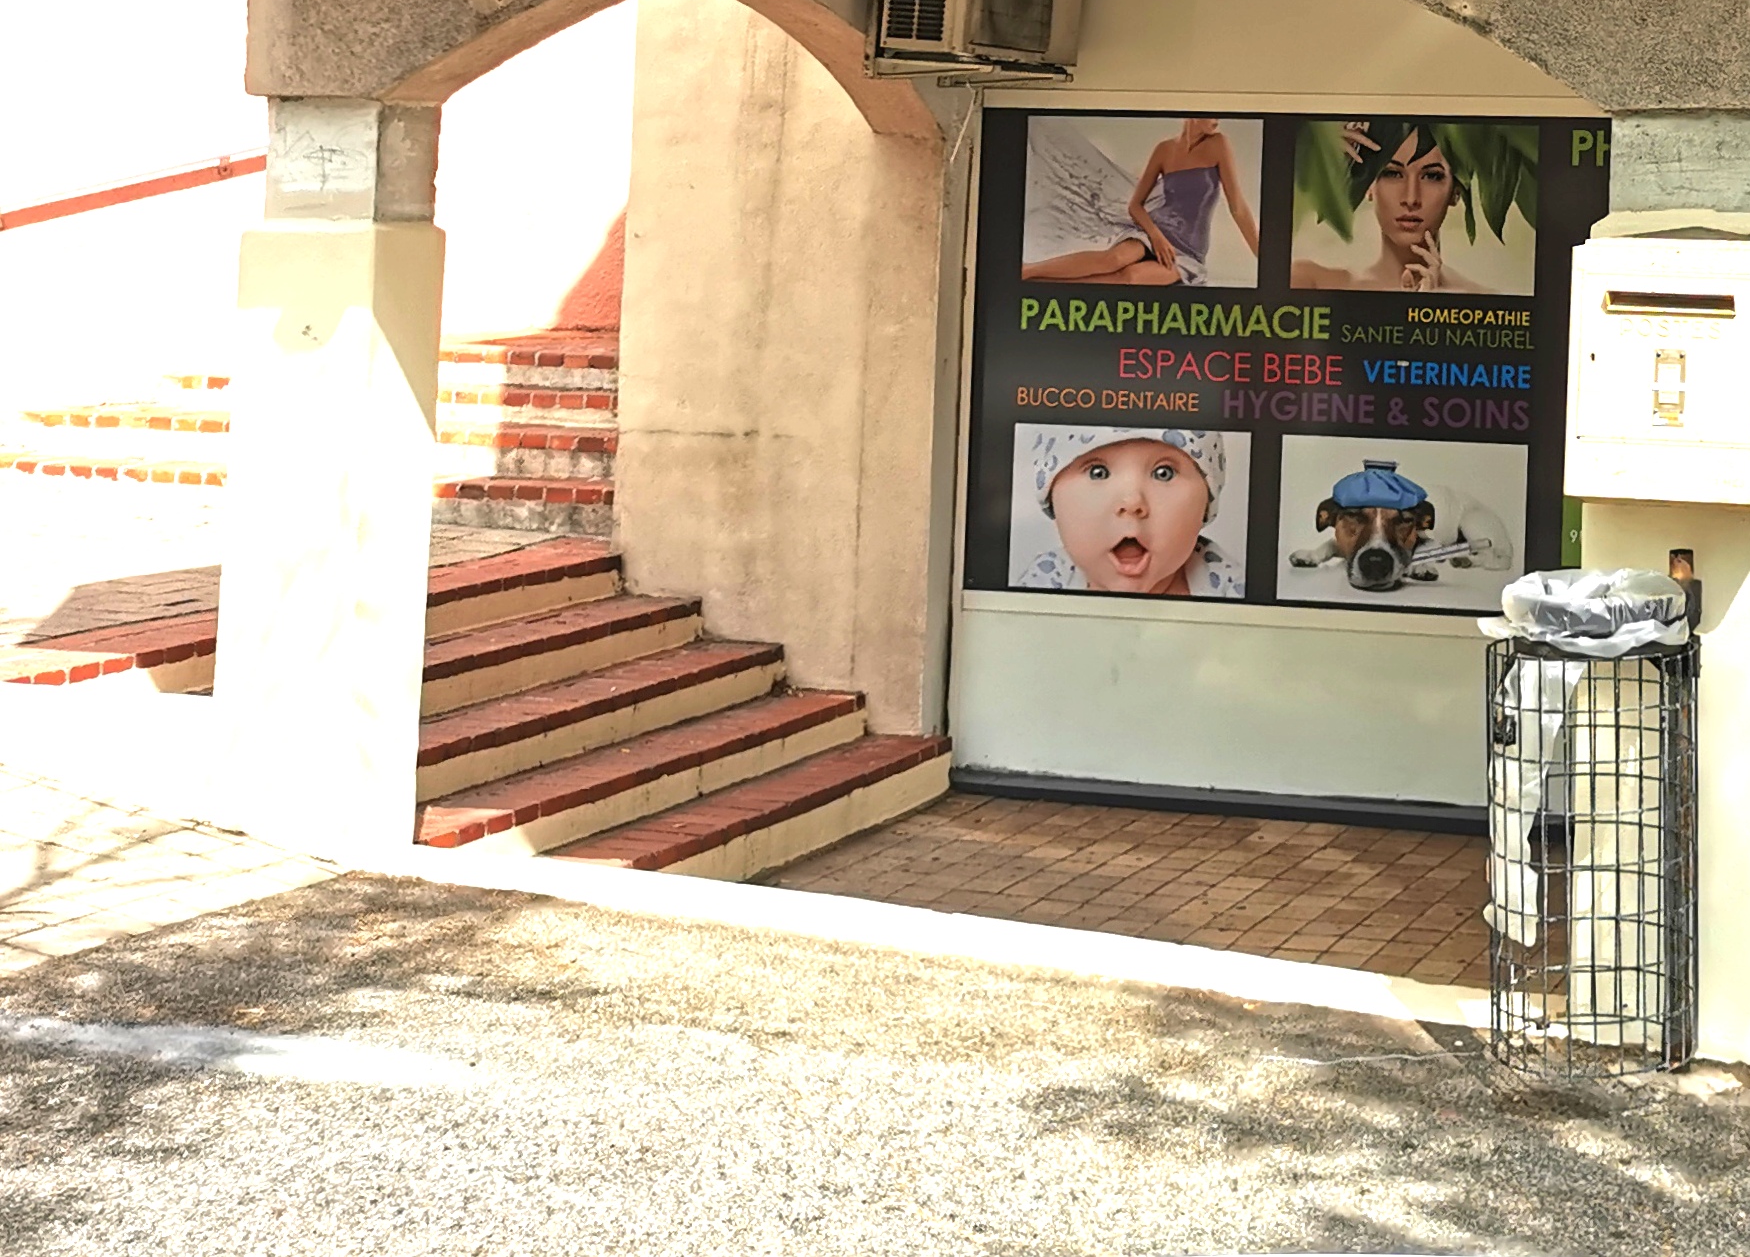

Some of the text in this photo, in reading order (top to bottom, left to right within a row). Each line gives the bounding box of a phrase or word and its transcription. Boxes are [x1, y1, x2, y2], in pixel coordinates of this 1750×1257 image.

[1020, 297, 1331, 340] PARAPHARMACIE
[1408, 307, 1531, 327] HOMEOPATHIE
[1341, 324, 1535, 350] SANTE AU NATUREL
[1119, 348, 1343, 386] ESPACE BEBE
[1363, 359, 1531, 390] VETERINAIRE
[1017, 387, 1200, 412] BUCCO DENTAIRE
[1223, 389, 1531, 431] HYGIENE & SOINS
